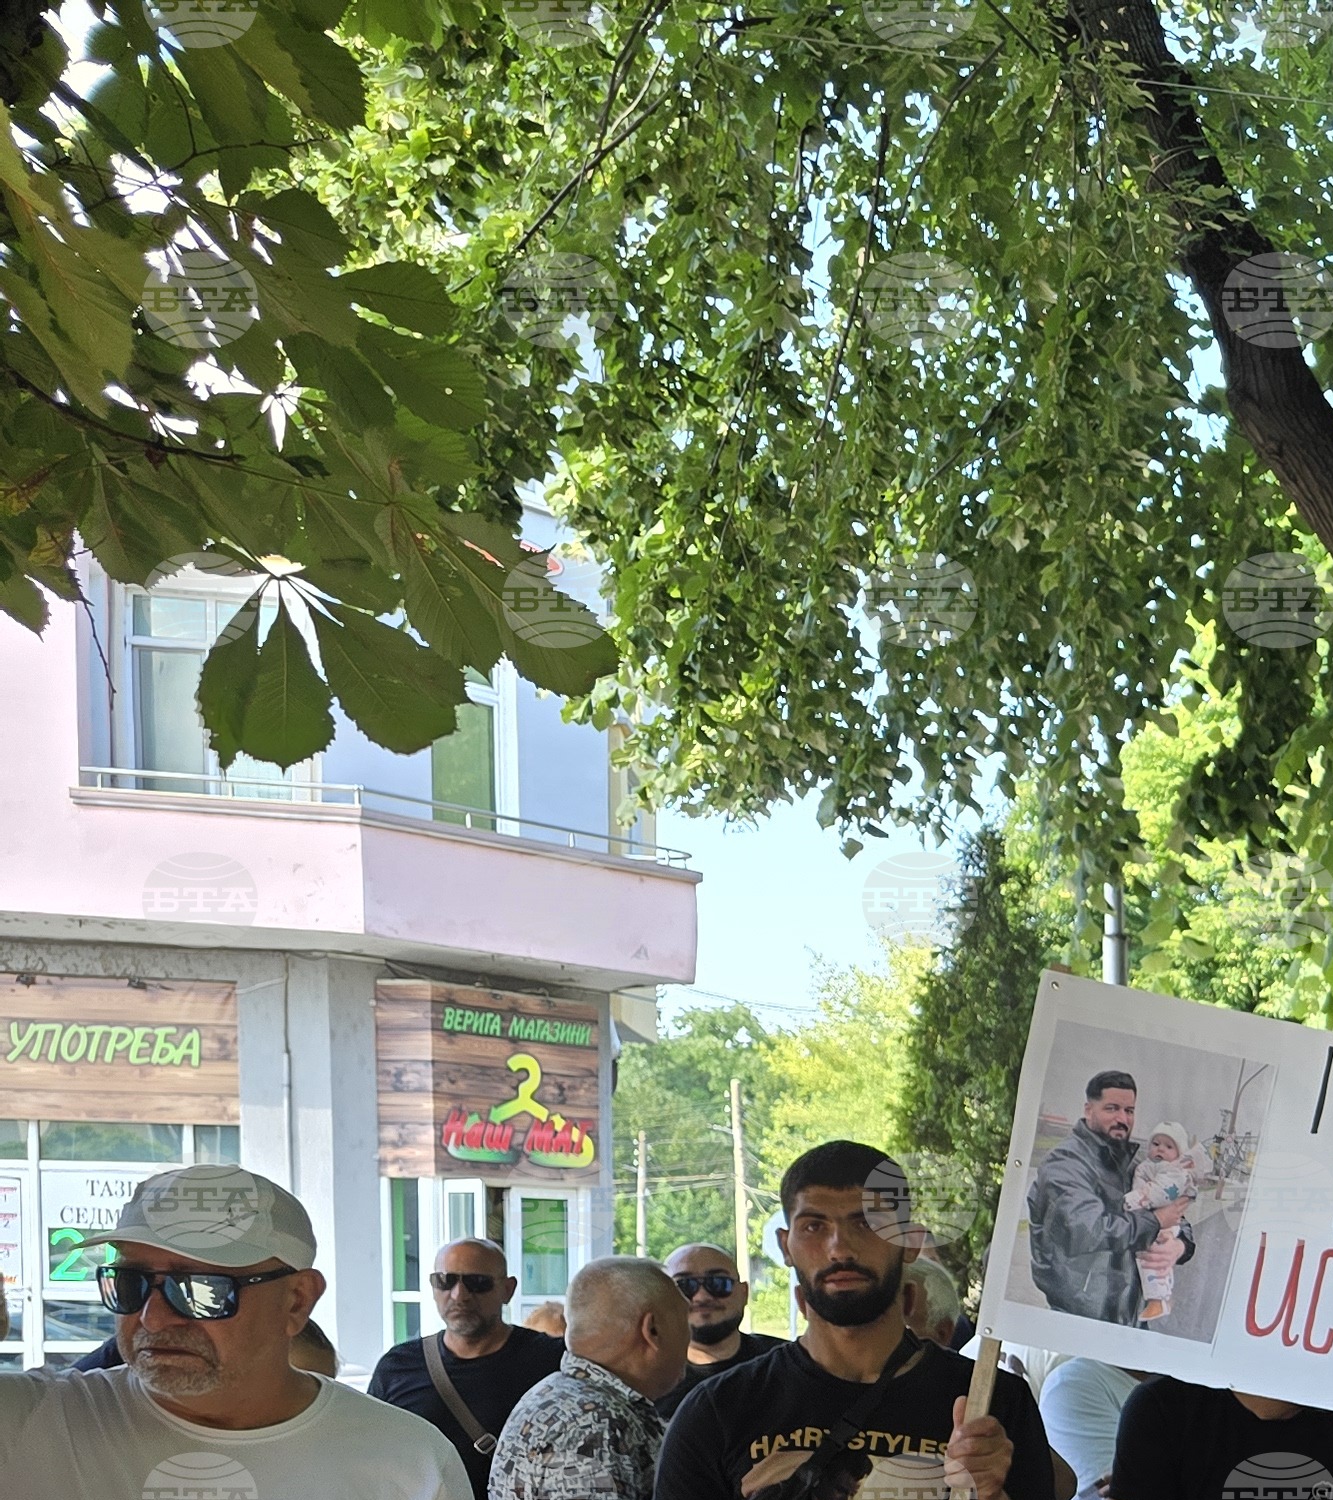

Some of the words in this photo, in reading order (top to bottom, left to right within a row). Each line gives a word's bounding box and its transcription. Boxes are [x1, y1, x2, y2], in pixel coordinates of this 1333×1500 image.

[6, 1021, 201, 1068] УПОТРЕБА
[442, 1006, 501, 1037] ВЕРИГА
[508, 1014, 592, 1046] МАГАЗИНИ
[750, 1426, 831, 1460] HARR
